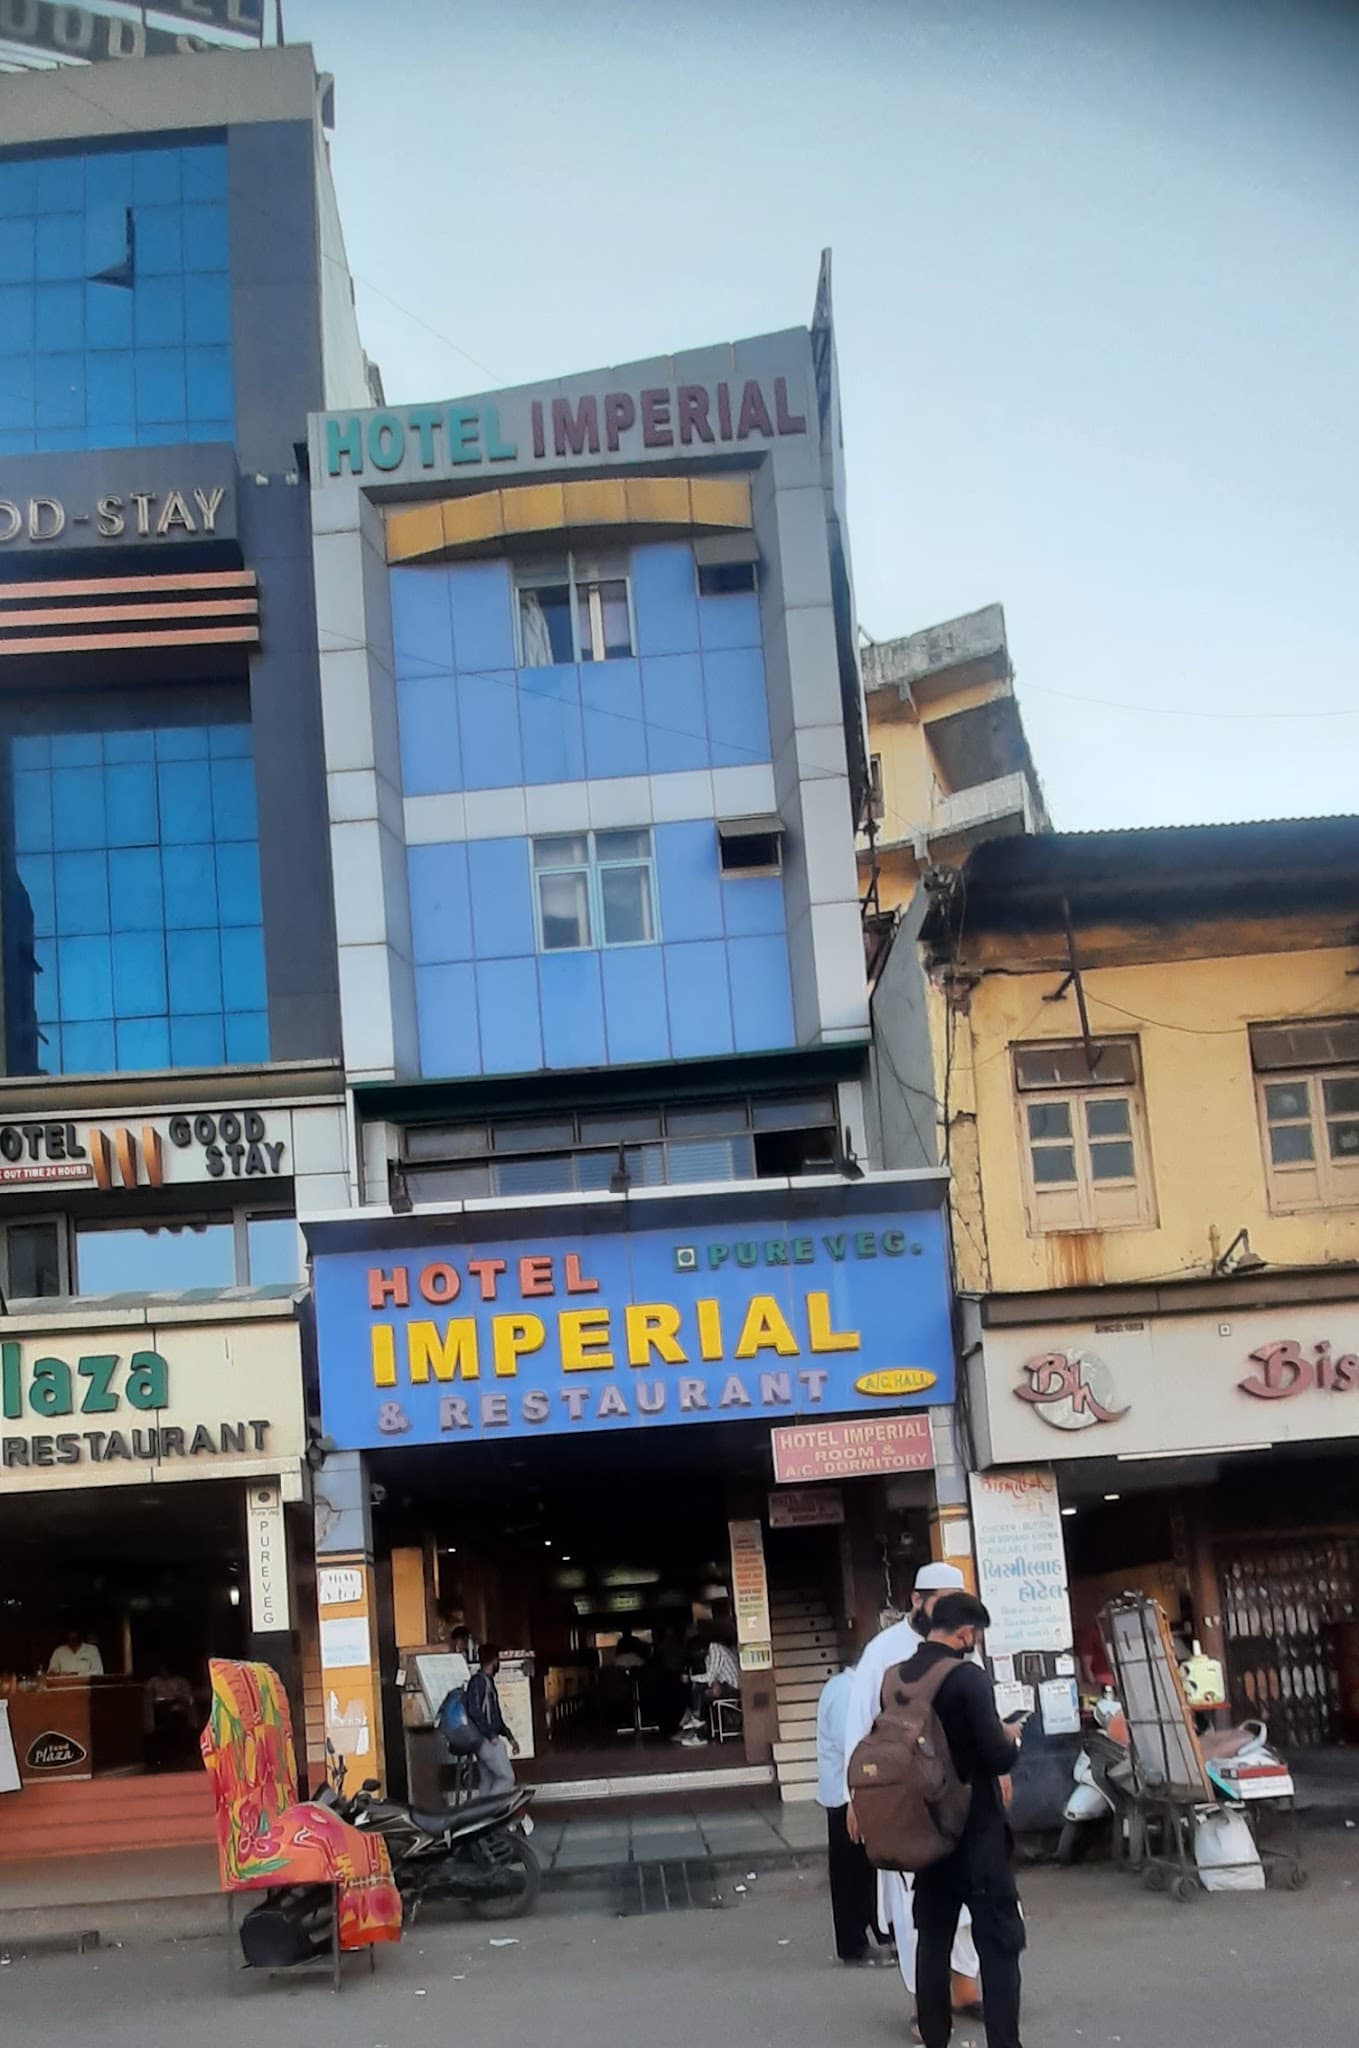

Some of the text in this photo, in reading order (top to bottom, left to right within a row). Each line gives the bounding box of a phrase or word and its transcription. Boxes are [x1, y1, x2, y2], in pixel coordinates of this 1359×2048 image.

[326, 377, 806, 476] HOTEL IMPERIAL
[169, 1110, 265, 1148] GOOD
[4, 1169, 21, 1180] OUT
[58, 1165, 87, 1176] HOURS
[205, 1142, 285, 1177] STAY
[707, 1237, 814, 1270] PURE
[368, 1253, 598, 1310] HOTEL
[370, 1291, 861, 1387] IMPERIAL
[377, 1370, 827, 1434] & RESTAURANT
[2, 1420, 270, 1467] RESTAURANT
[780, 1422, 928, 1449] HOTEL IMPERIAL
[815, 1445, 897, 1462] ROOM &
[824, 1453, 928, 1474] DORMITORY
